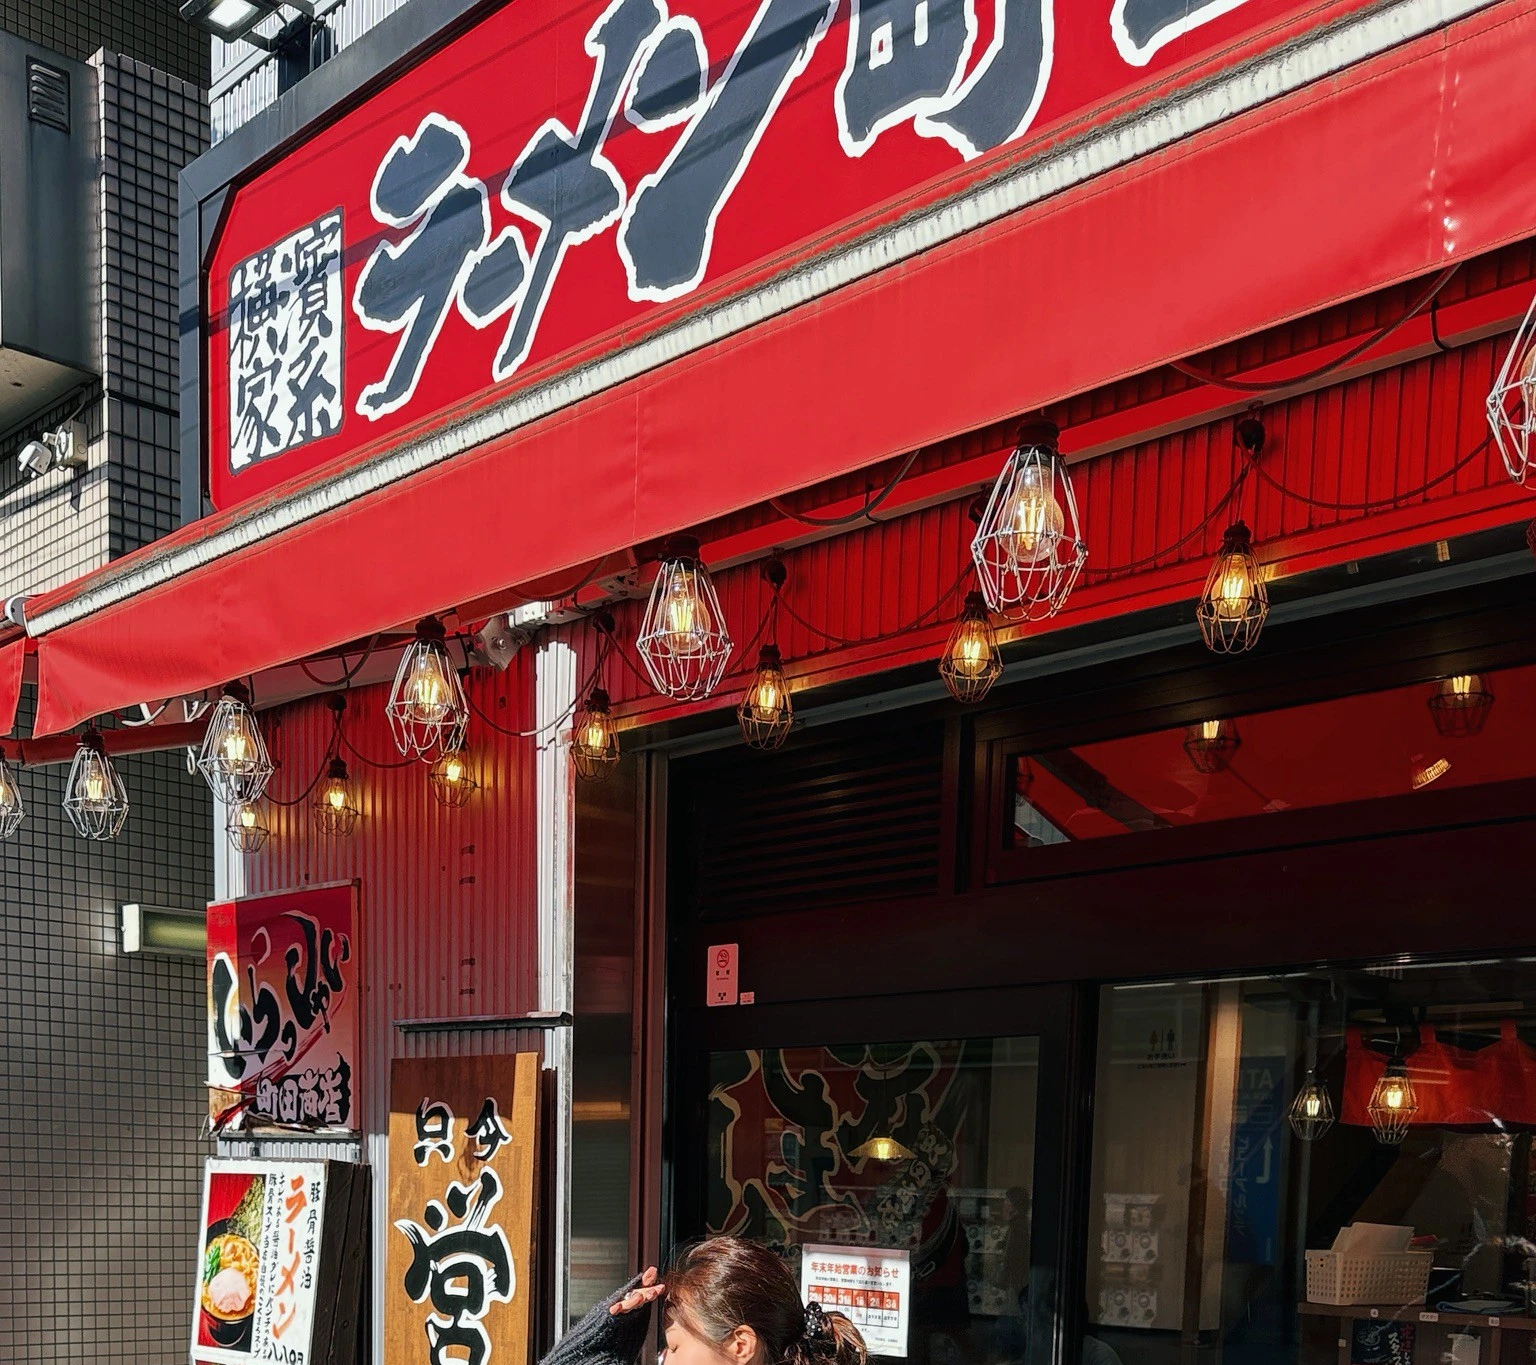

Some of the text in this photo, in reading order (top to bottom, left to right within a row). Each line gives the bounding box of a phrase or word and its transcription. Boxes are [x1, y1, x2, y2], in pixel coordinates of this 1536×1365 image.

[255, 1066, 347, 1125] 町田商店
[272, 1175, 308, 1340] ラーメン
[810, 1261, 900, 1279] 年末年始営業のお知らせ
